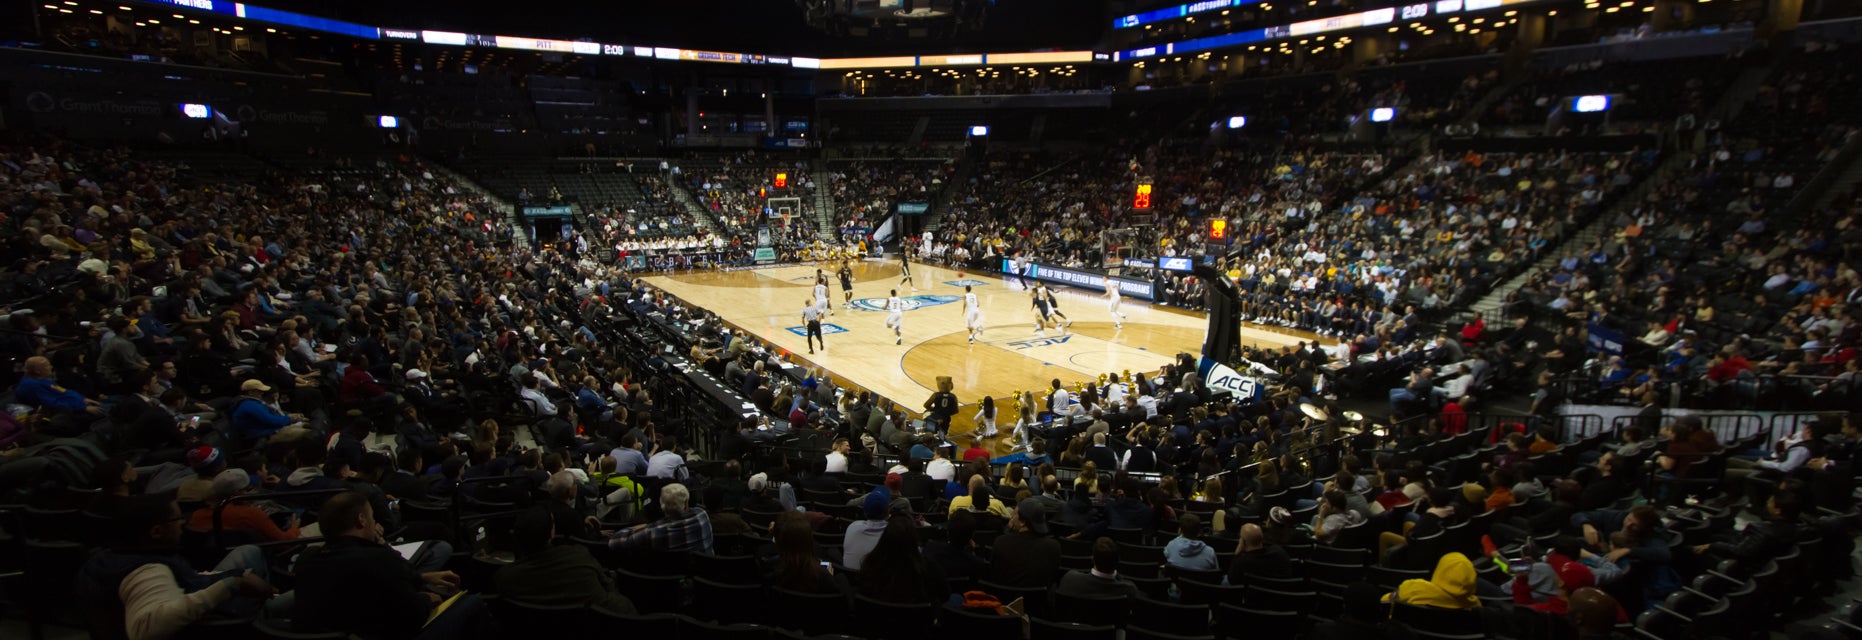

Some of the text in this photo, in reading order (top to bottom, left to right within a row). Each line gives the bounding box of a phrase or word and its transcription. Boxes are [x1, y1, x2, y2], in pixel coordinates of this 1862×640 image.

[1402, 4, 1427, 19] 2:09
[386, 30, 417, 38] TURNOVERS
[536, 40, 552, 49] PITT
[604, 45, 623, 55] 2:09
[1164, 258, 1188, 269] ACC
[1038, 267, 1047, 276] FIVE
[1048, 269, 1053, 277] OF
[1054, 270, 1062, 279] THE
[1063, 272, 1072, 281] TOP
[1072, 273, 1089, 284] ELEVEN
[1120, 281, 1150, 295] PROGRAMS
[1007, 334, 1073, 350] ACC
[1212, 375, 1252, 392] ACC
